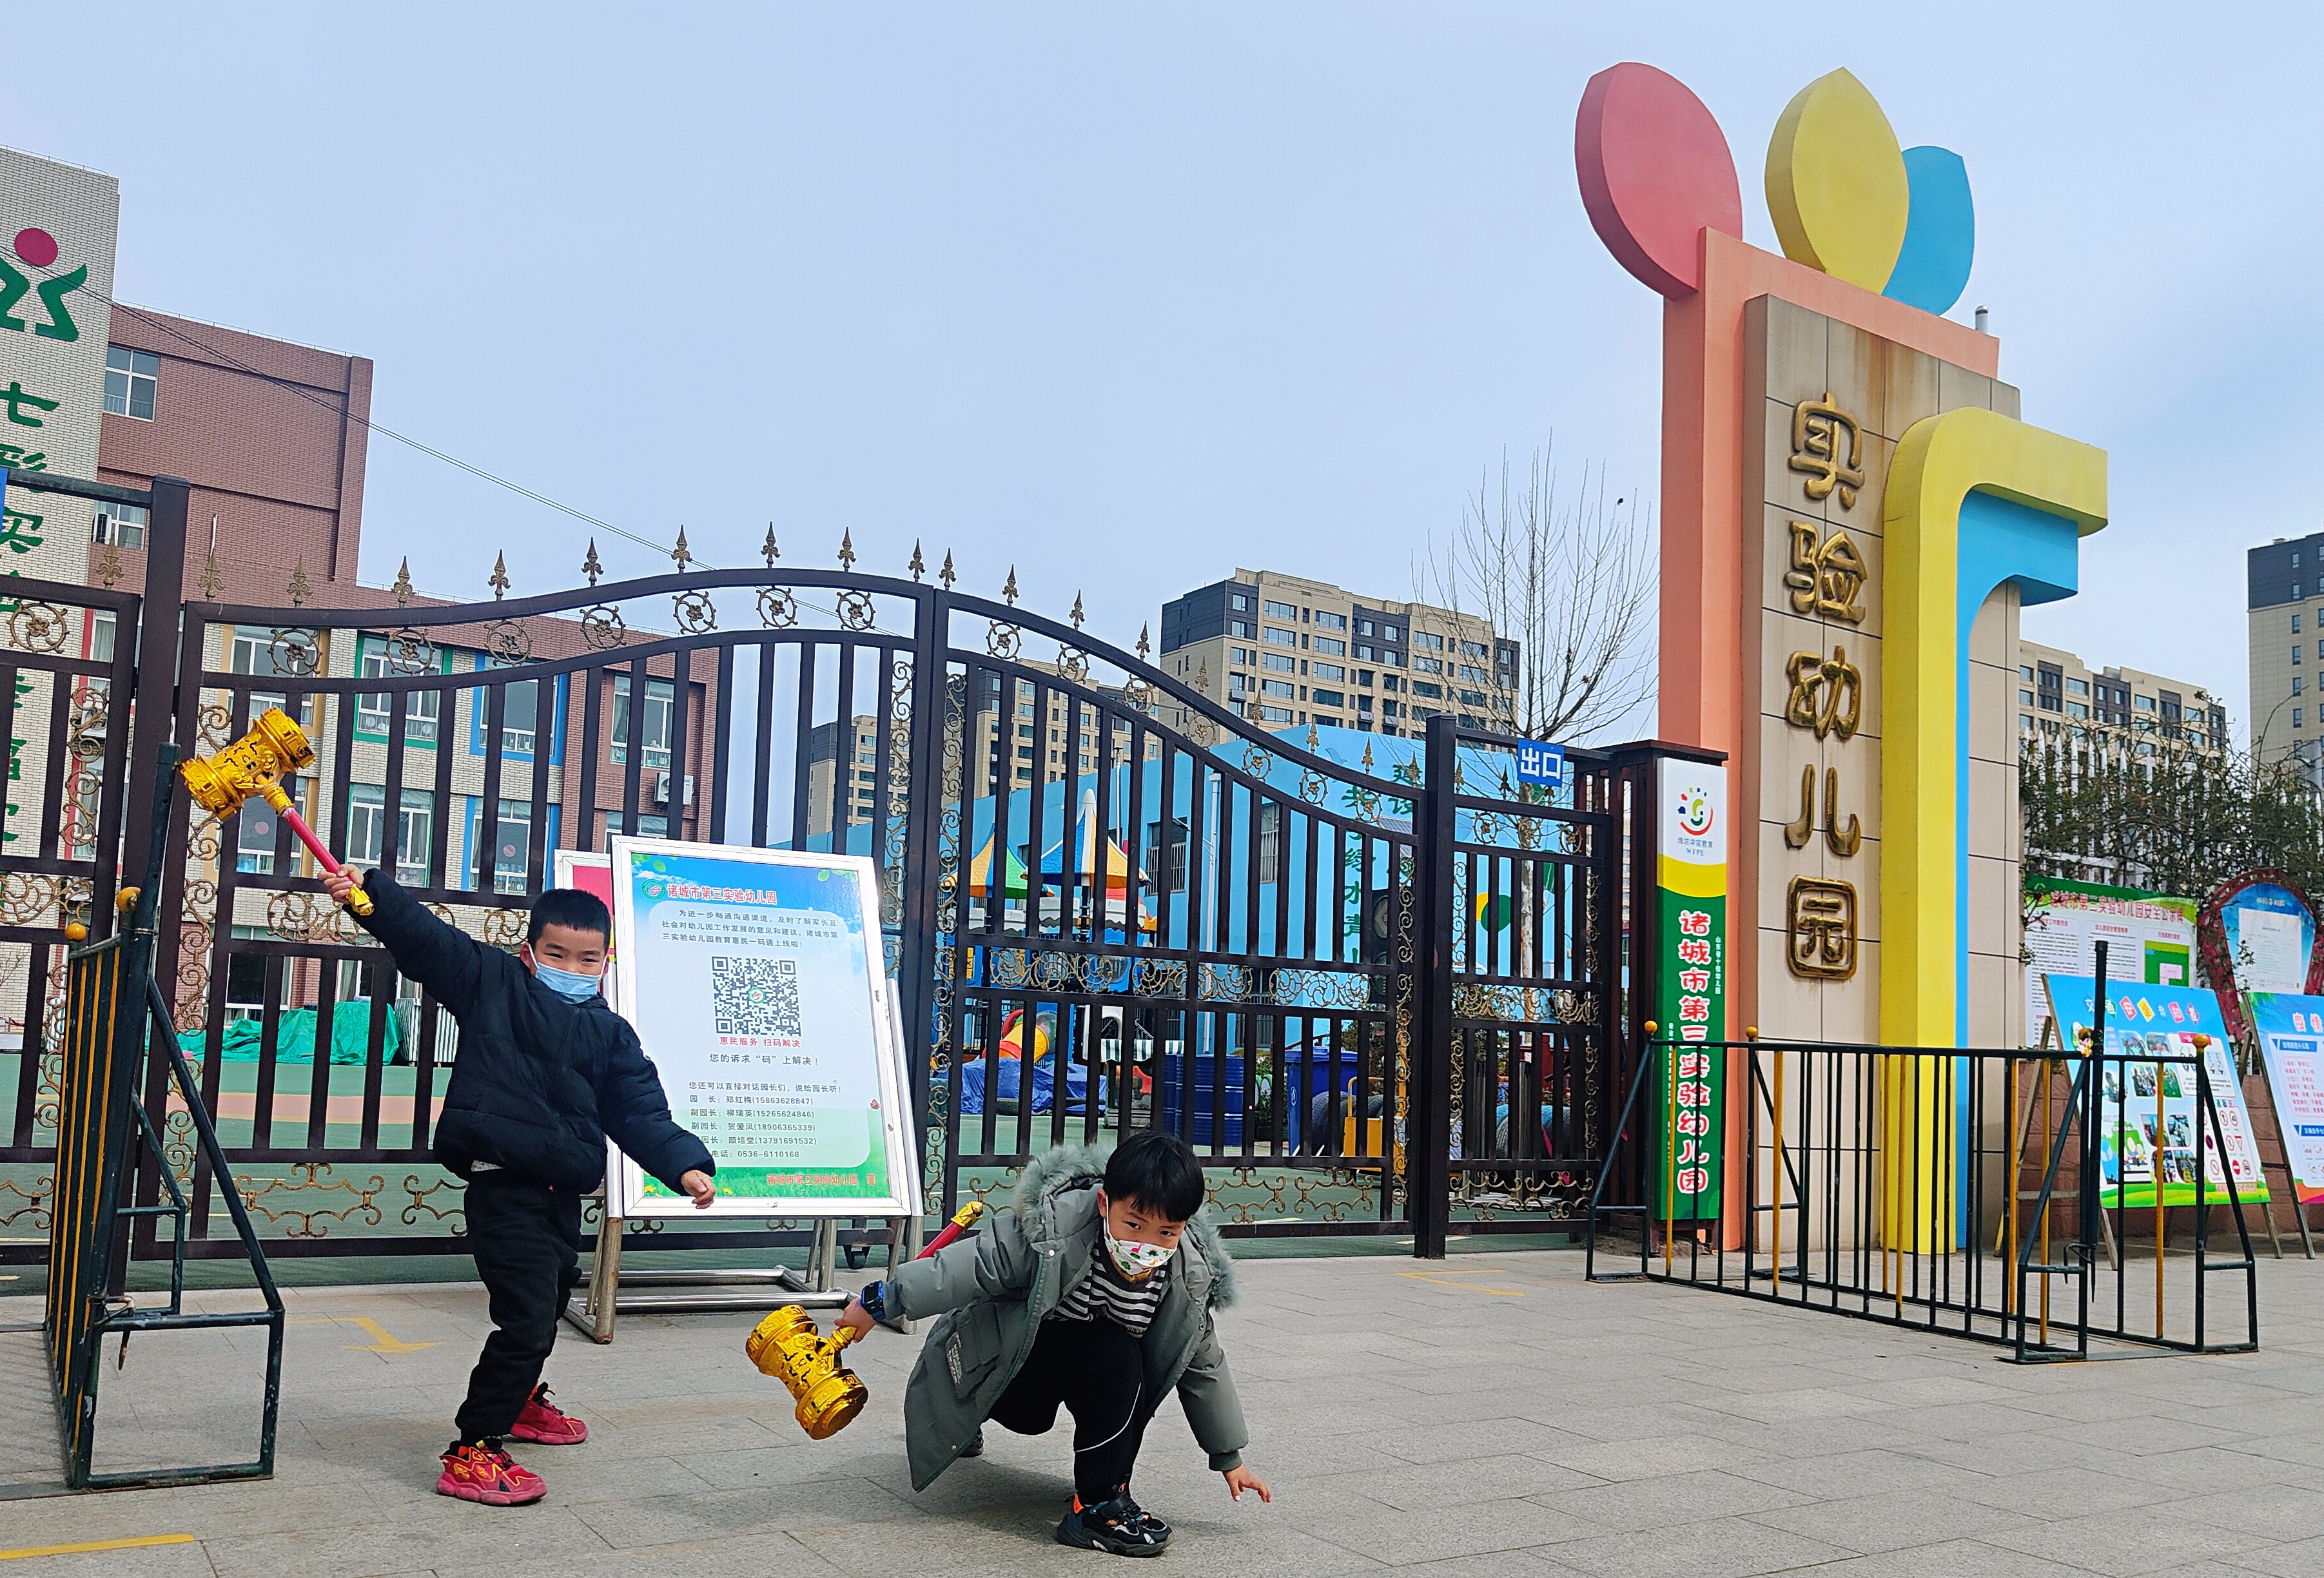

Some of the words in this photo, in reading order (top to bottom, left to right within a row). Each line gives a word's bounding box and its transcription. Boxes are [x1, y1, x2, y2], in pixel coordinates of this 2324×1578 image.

[1783, 391, 1867, 980] 实验幼儿园
[1519, 741, 1561, 781] 出口
[1686, 848, 1705, 857] WFPE
[667, 884, 777, 904] 诸城市第三实验幼儿园
[719, 1037, 757, 1046] 惠民服务
[763, 1038, 801, 1047] 扫码解决
[1677, 910, 1712, 1194] 诸城市第三实验幼儿园
[697, 1136, 817, 1145] 园长：颜培堂(13791691532)
[767, 1173, 858, 1185] 诸城市第三实验幼儿园
